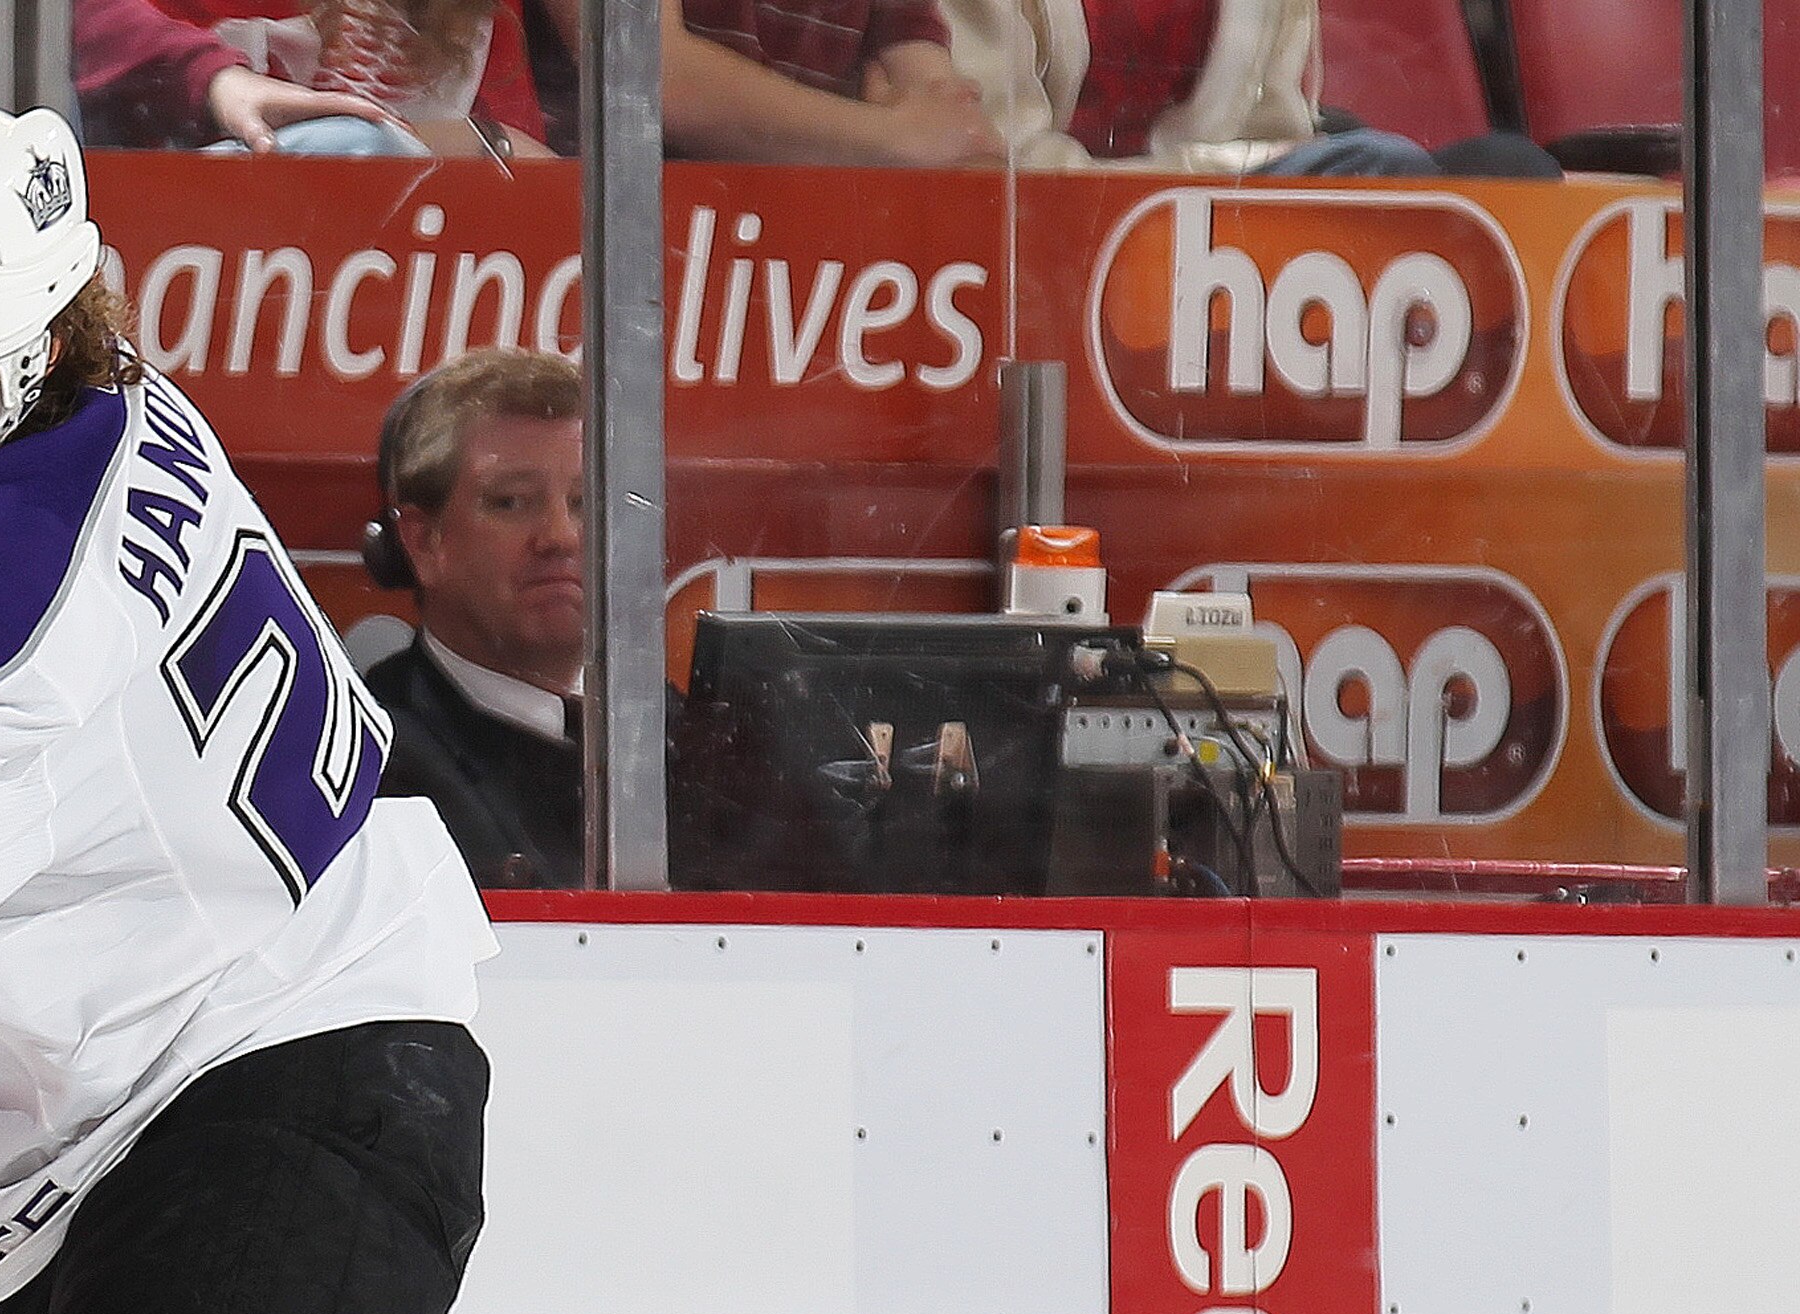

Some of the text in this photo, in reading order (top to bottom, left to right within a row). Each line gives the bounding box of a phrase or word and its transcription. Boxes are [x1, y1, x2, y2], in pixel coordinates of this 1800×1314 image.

[100, 204, 583, 376] ancin
[671, 204, 990, 390] lives
[1170, 198, 1473, 450] hap
[118, 380, 212, 630] HAND
